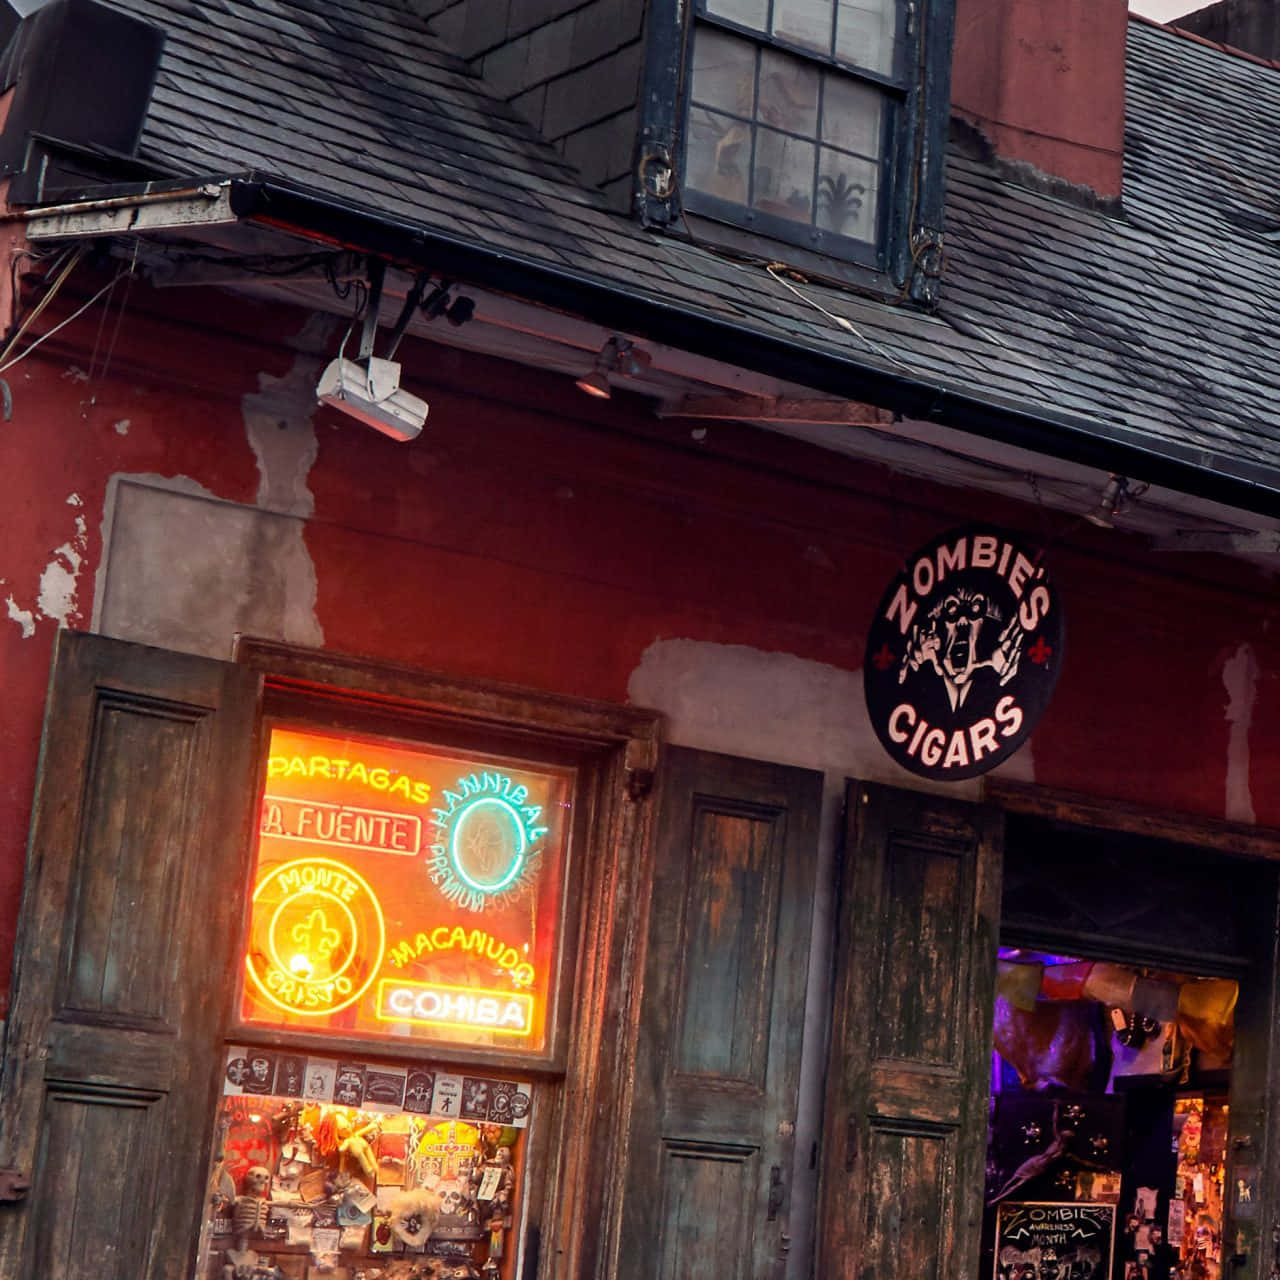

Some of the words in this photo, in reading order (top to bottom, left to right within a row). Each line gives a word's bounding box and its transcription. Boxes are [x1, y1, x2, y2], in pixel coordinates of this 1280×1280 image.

[885, 535, 1050, 634] ZOMBIE'S
[888, 695, 1023, 768] CIGARS
[267, 756, 432, 805] PARTAGAS
[429, 771, 549, 841] HANNIBAL
[297, 807, 408, 850] FUENTE
[277, 866, 360, 904] MONTE
[391, 926, 535, 987] MACANUDO
[265, 971, 353, 1008] CRISTO
[388, 988, 526, 1028] COHIBA
[1003, 1208, 1102, 1235] ZOMBIE
[1031, 1233, 1067, 1245] MONTH
